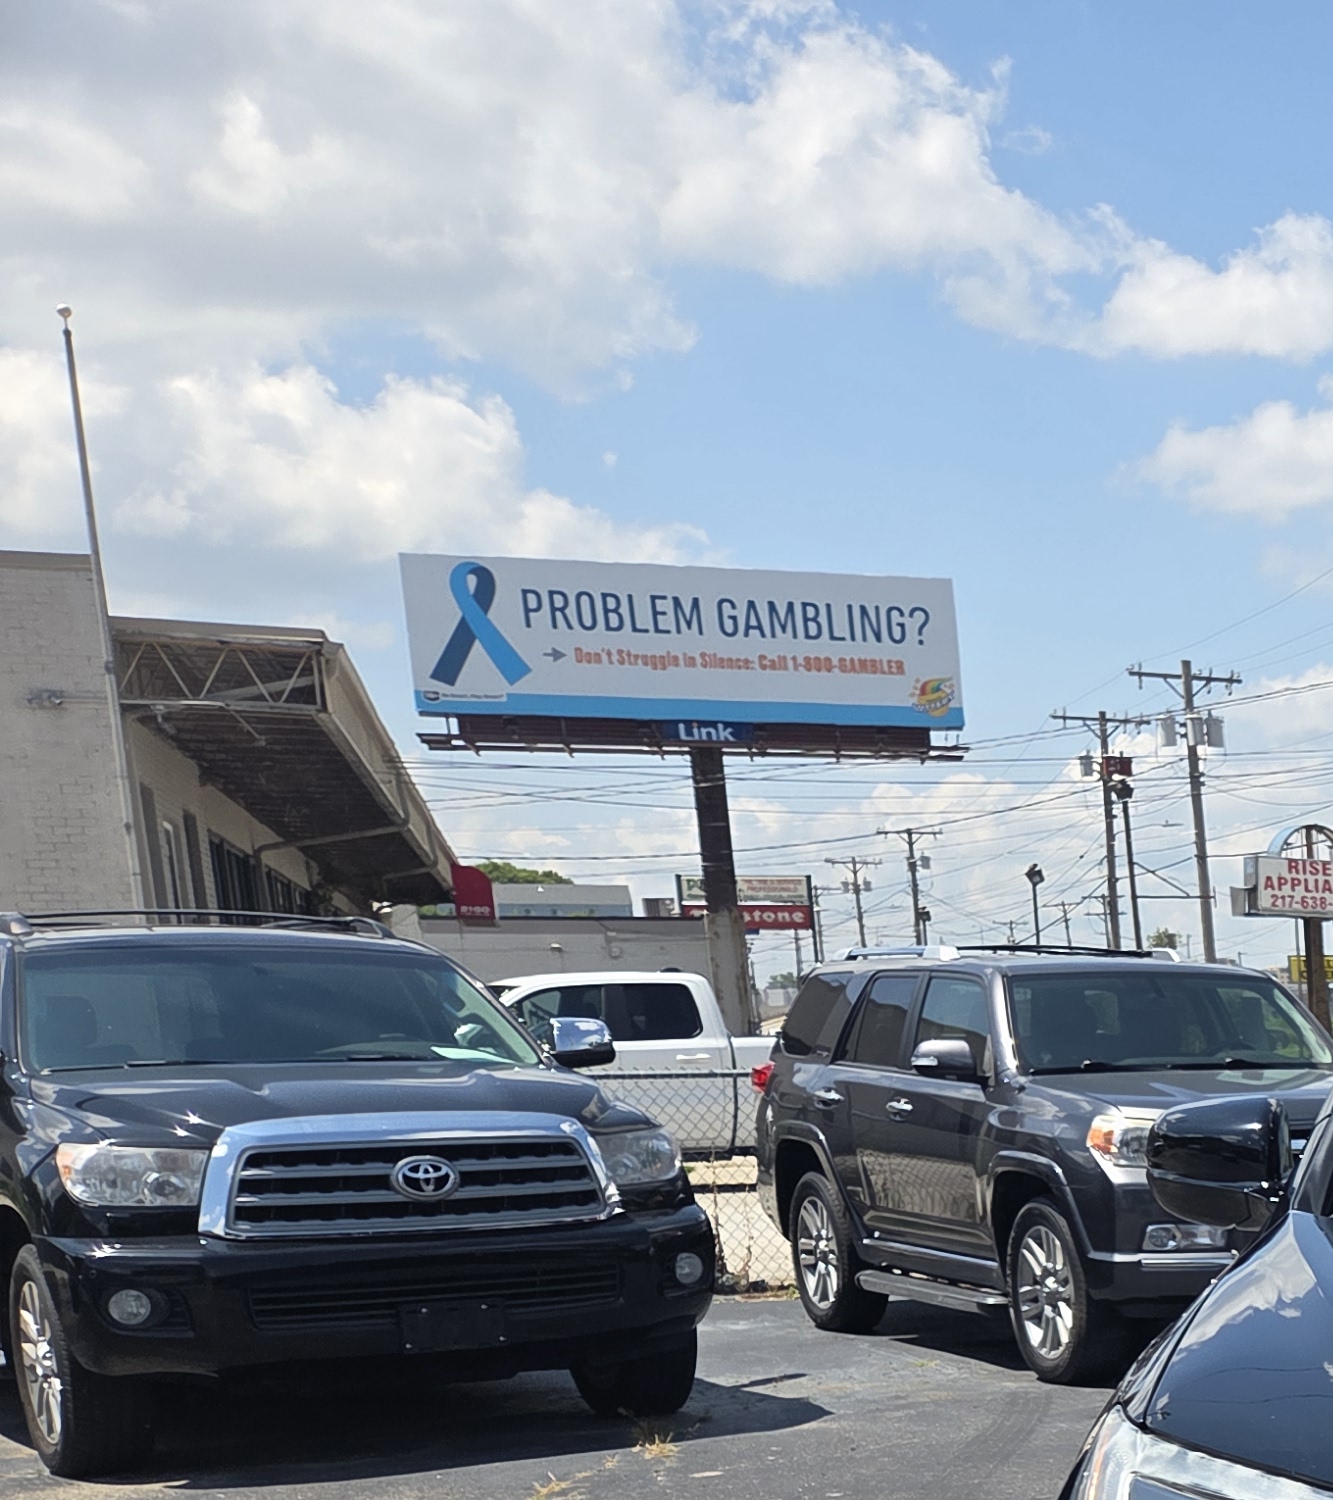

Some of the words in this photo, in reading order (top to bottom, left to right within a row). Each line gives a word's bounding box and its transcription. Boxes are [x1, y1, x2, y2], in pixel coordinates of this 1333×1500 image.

[519, 588, 704, 636] PROBLEM
[716, 598, 931, 646] GAMBLING?
[574, 647, 614, 665] Don't
[616, 649, 680, 671] Struggle
[682, 652, 698, 668] in
[758, 654, 788, 671] Call
[790, 655, 906, 676] 1-800-GAMBLER
[678, 722, 737, 741] Link
